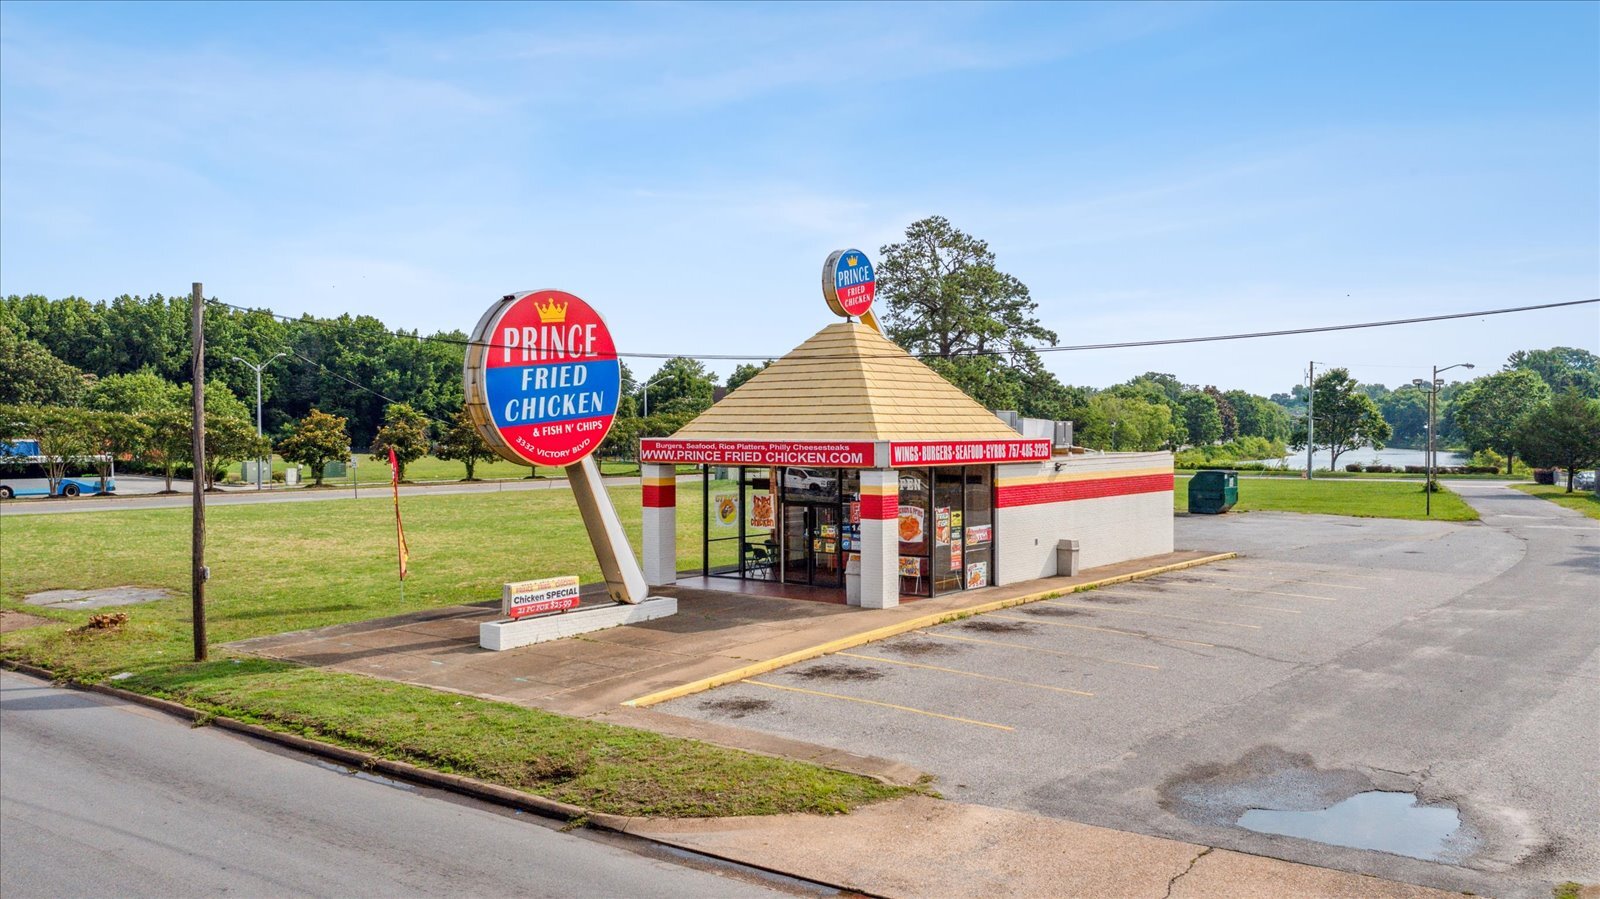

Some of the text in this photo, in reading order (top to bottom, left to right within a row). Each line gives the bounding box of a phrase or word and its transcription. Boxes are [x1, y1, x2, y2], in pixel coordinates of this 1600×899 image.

[839, 266, 870, 287] PRINCE
[848, 286, 865, 296] FRIED
[845, 294, 870, 307] CHICKEN
[504, 324, 598, 363] PRINCE
[522, 364, 587, 390] FRIED
[505, 391, 604, 422] CHICKEN
[533, 428, 540, 437] &
[542, 424, 562, 436] FISH
[577, 420, 603, 432] CHIPS
[516, 436, 590, 458] 3332 VICTORY BLVD
[656, 442, 684, 450] Burgers,
[769, 444, 792, 452] Philly
[894, 445, 919, 462] WINGS
[922, 445, 952, 461] BURGERS
[955, 444, 983, 460] SEAFOOD
[985, 444, 1006, 459] GYROS
[642, 450, 863, 464] WWW.PRINCE FRIED CHICKEN.COM
[514, 587, 578, 604] Chicken SPECIAL
